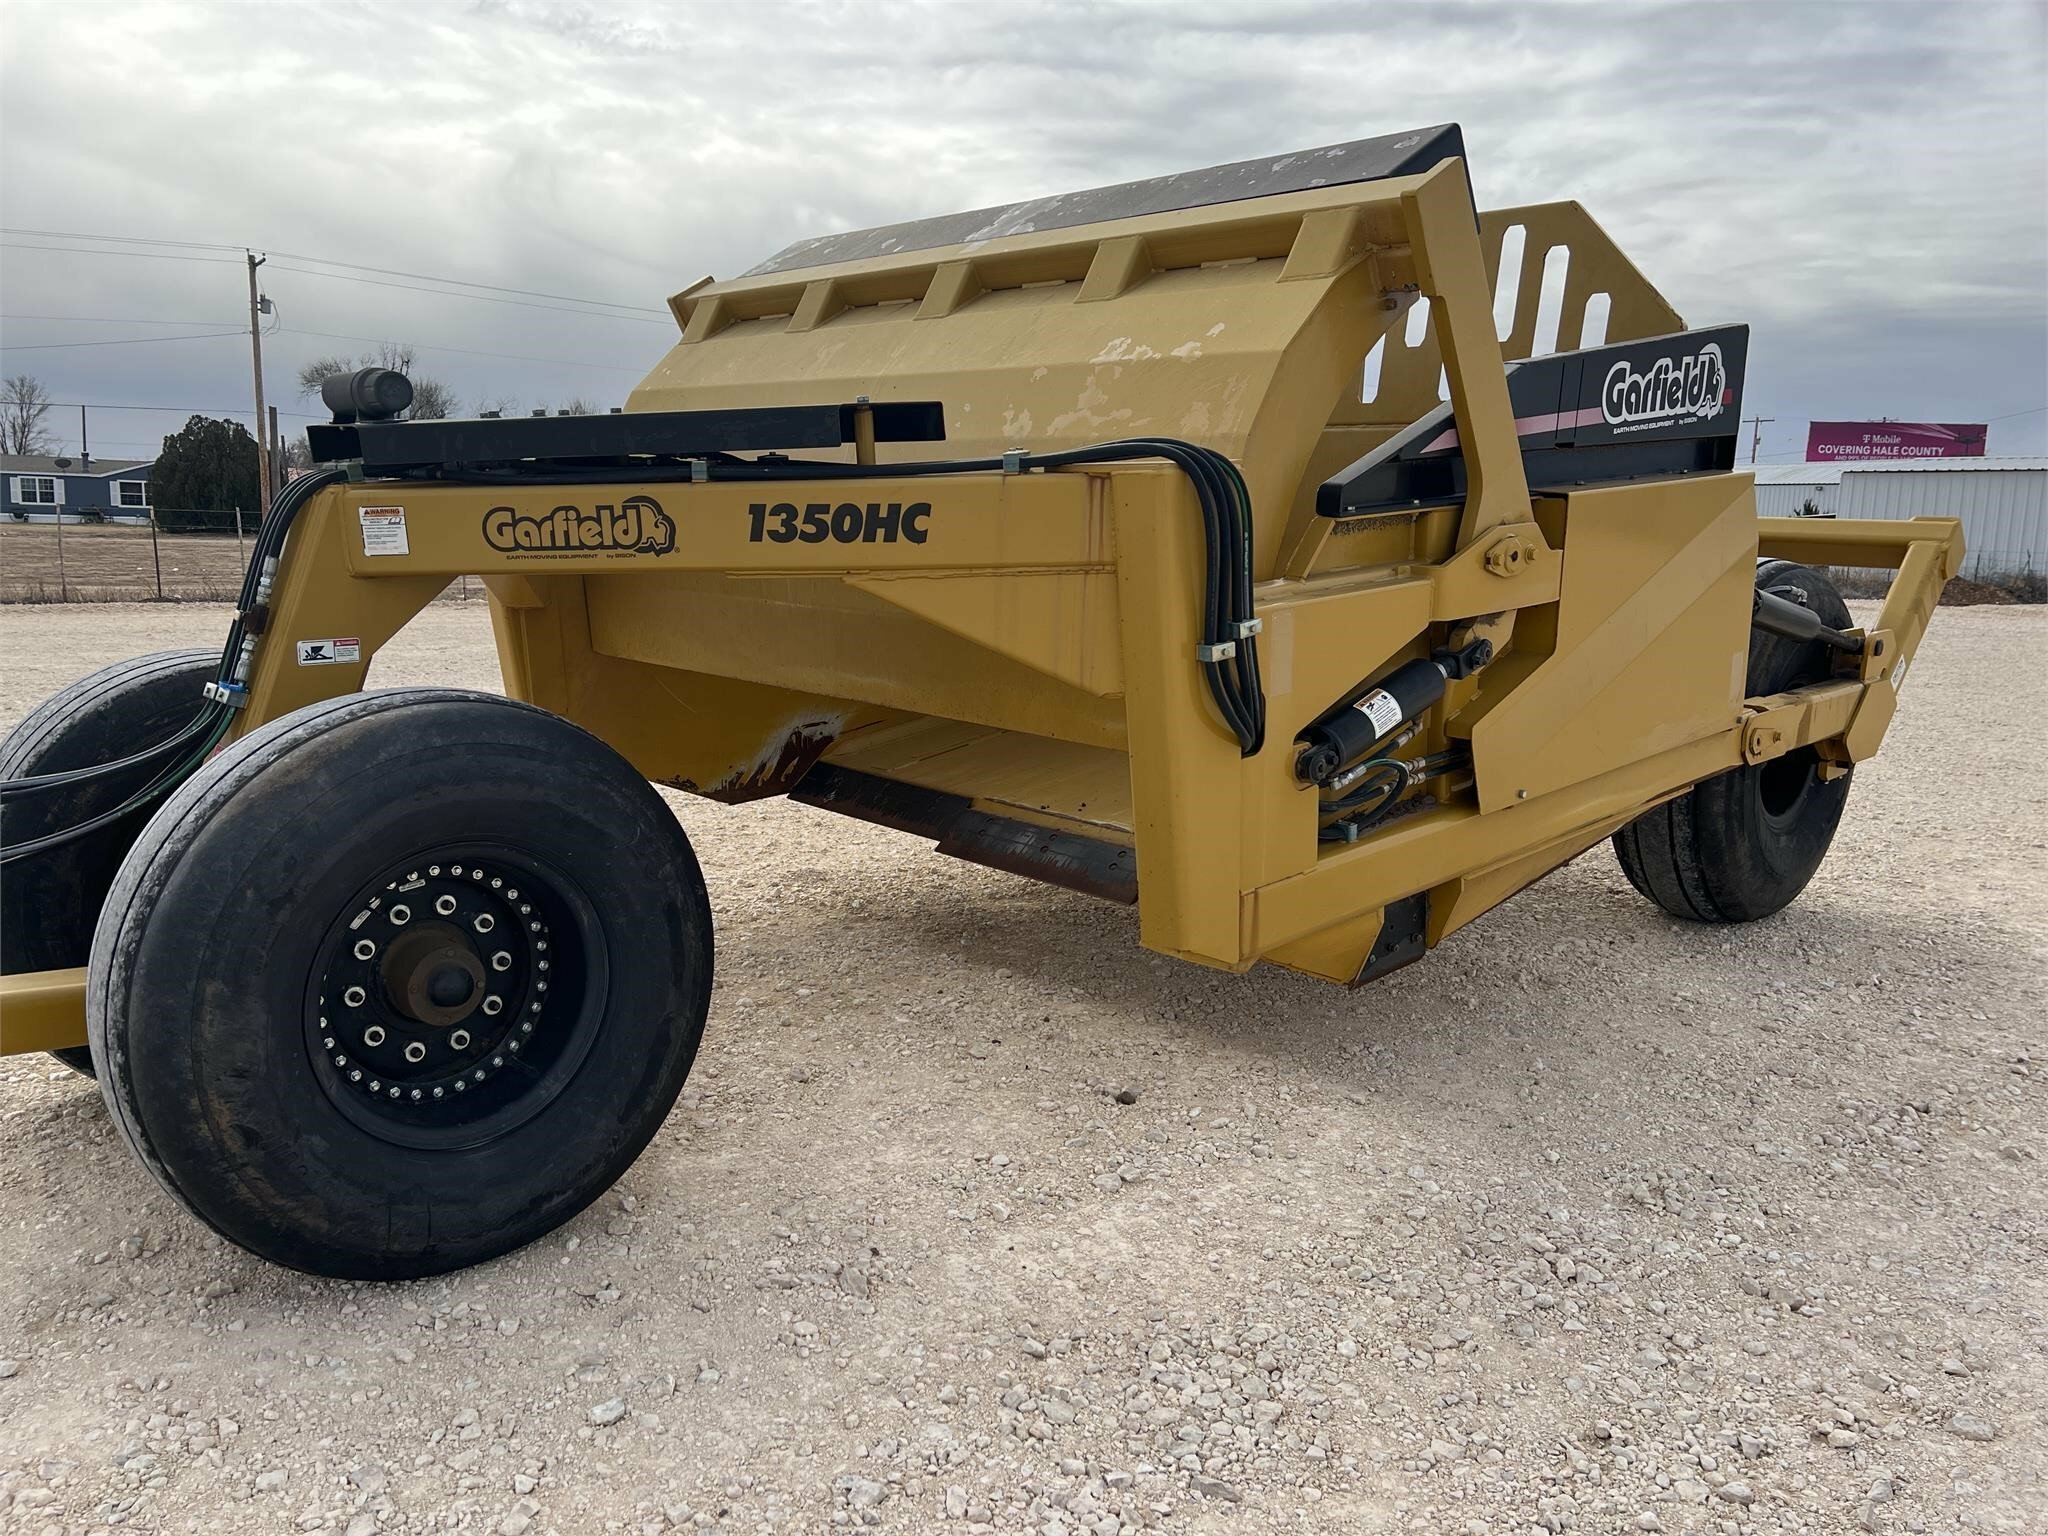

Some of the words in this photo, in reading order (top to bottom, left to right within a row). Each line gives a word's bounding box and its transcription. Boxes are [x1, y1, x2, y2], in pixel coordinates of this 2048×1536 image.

[1602, 354, 1710, 425] Garfield
[1613, 426, 1630, 434] EARTH
[1872, 434, 1902, 444] Mobile
[1818, 444, 1871, 455] COVERING
[1872, 446, 1900, 455] HALE
[1901, 446, 1945, 456] COUNTY
[482, 505, 642, 552] Garfield
[748, 502, 932, 544] 1350HC
